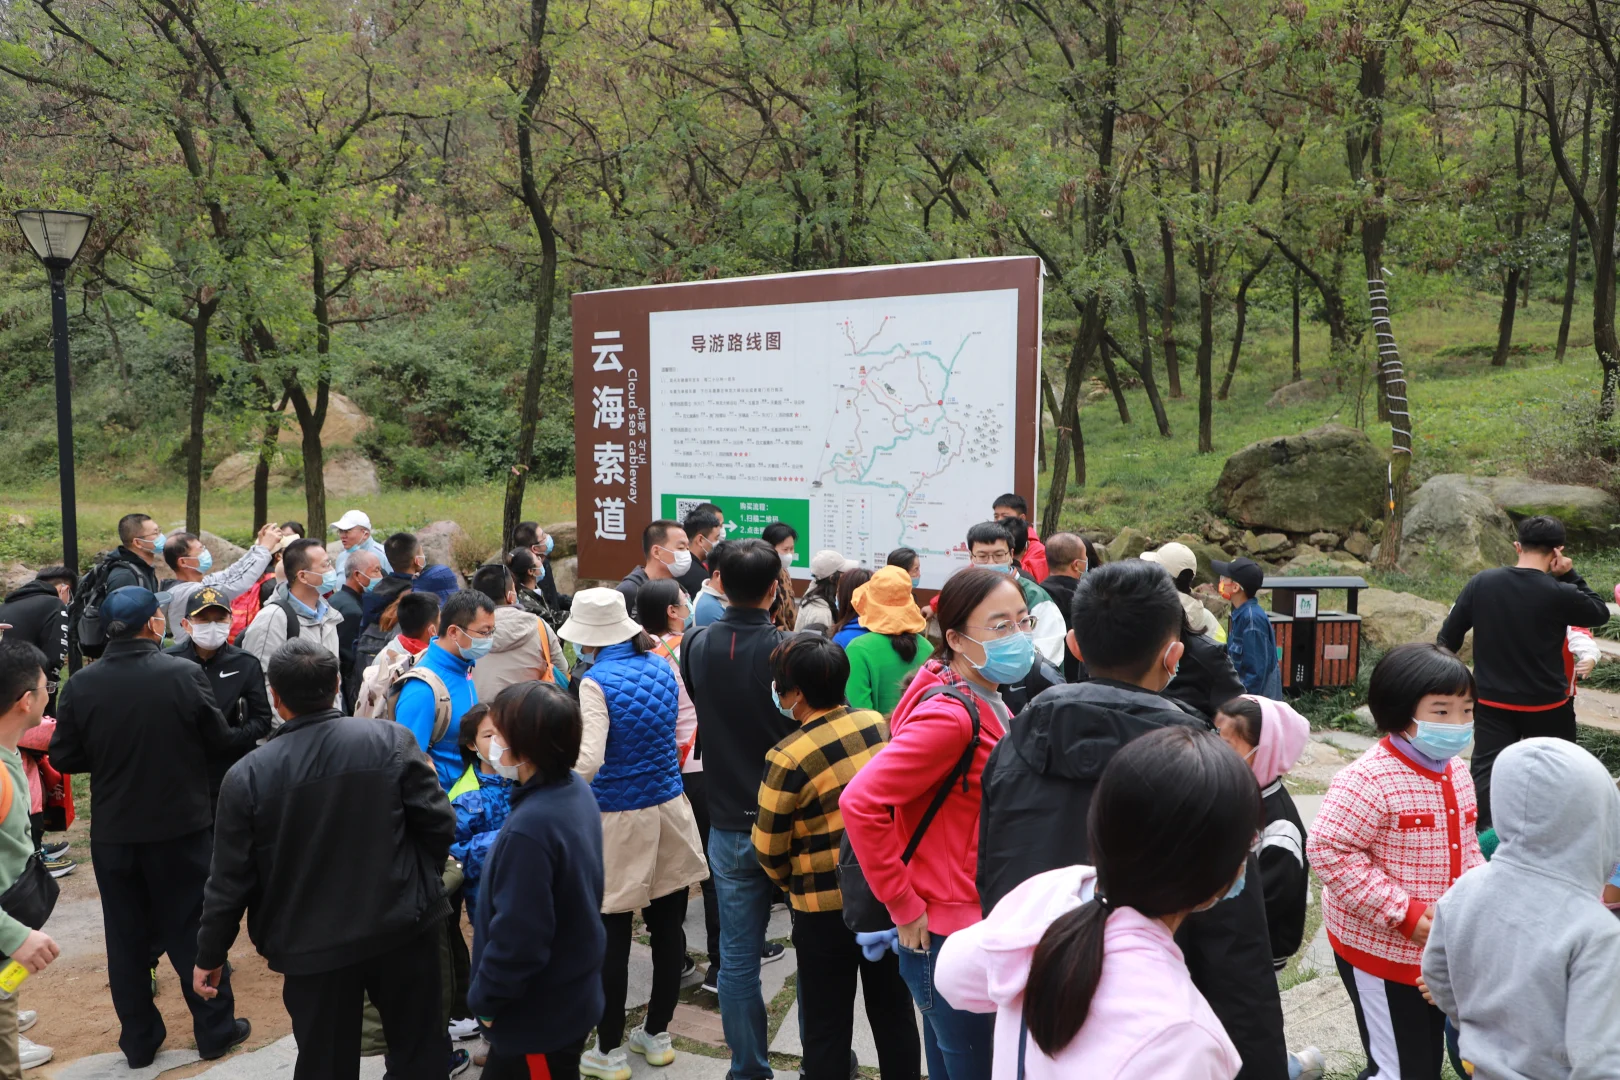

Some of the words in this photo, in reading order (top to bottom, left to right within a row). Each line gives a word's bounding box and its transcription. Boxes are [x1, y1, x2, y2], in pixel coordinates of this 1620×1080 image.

[691, 331, 781, 353] 导游路线图
[628, 368, 638, 409] Cloud
[591, 330, 627, 541] 云海索道
[628, 440, 640, 504] cableway
